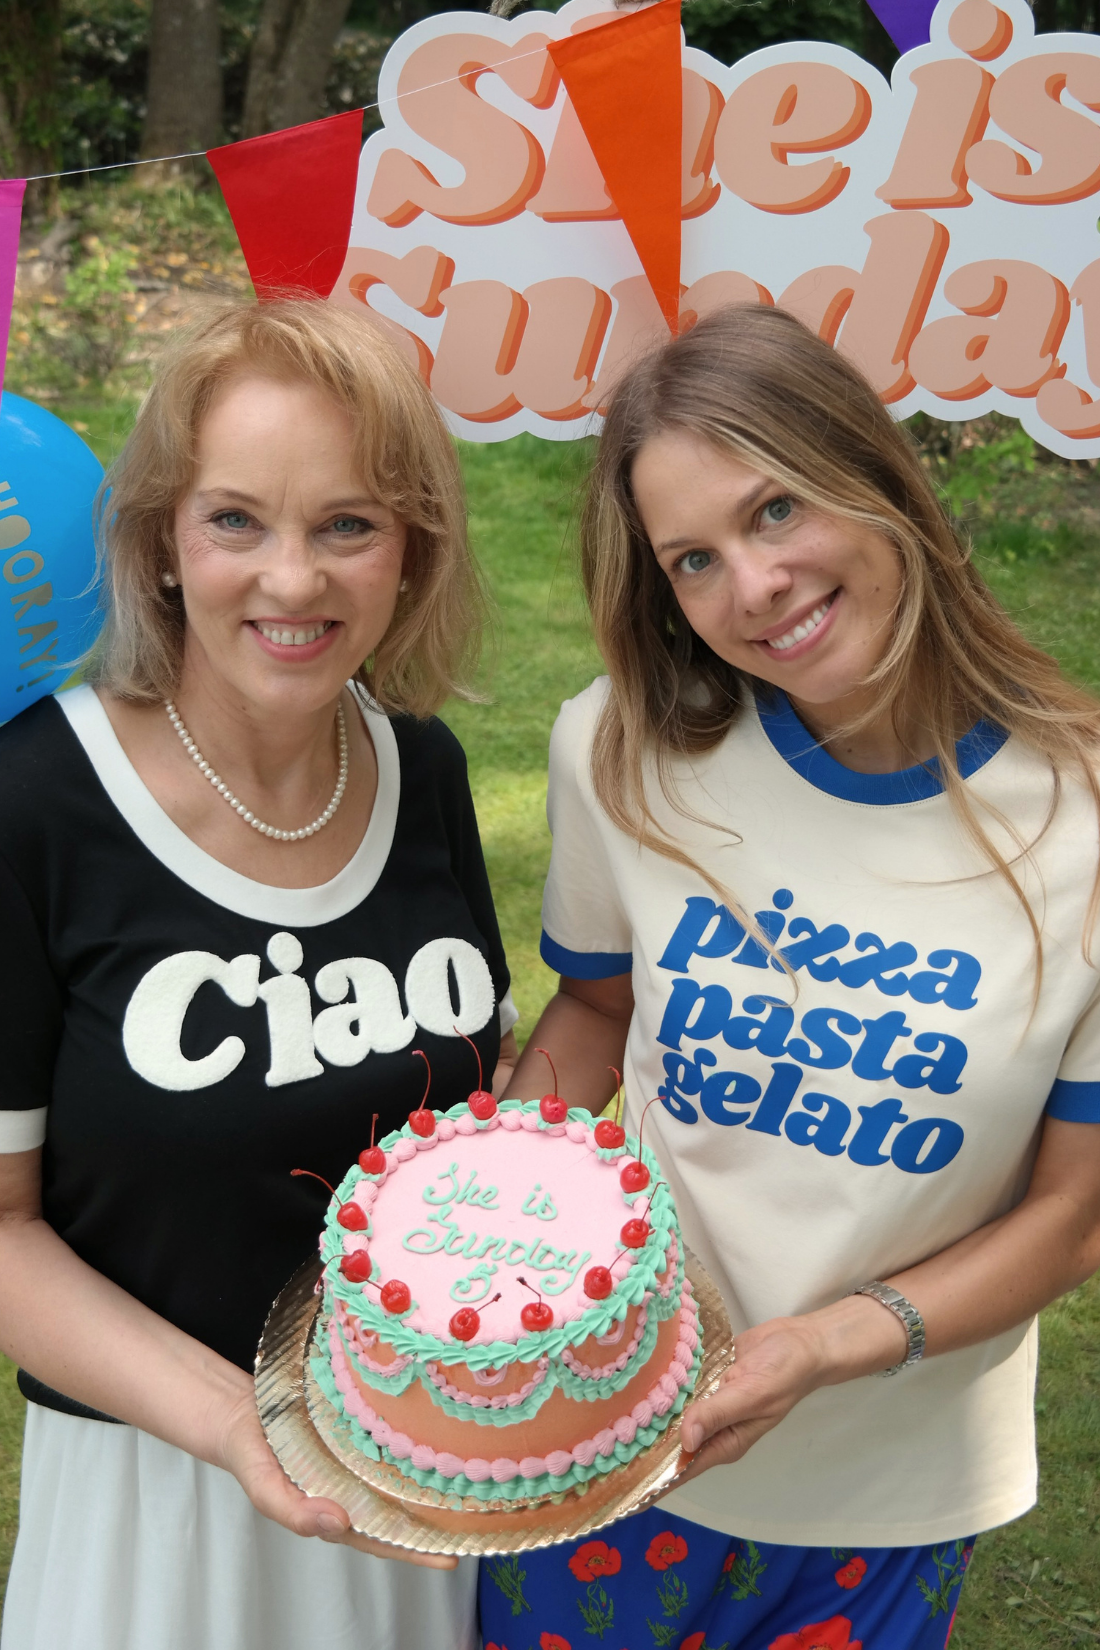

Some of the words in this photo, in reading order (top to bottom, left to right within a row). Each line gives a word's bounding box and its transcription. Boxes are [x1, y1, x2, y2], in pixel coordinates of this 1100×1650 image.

[875, 0, 1100, 210] is
[326, 210, 1100, 440] Suda
[656, 888, 982, 1010] pizza
[122, 931, 496, 1092] Ciao
[656, 978, 968, 1095] pasta
[657, 1047, 965, 1174] gelato
[402, 1204, 591, 1296] Sunday
[422, 1162, 500, 1210] She
[522, 1183, 558, 1221] is
